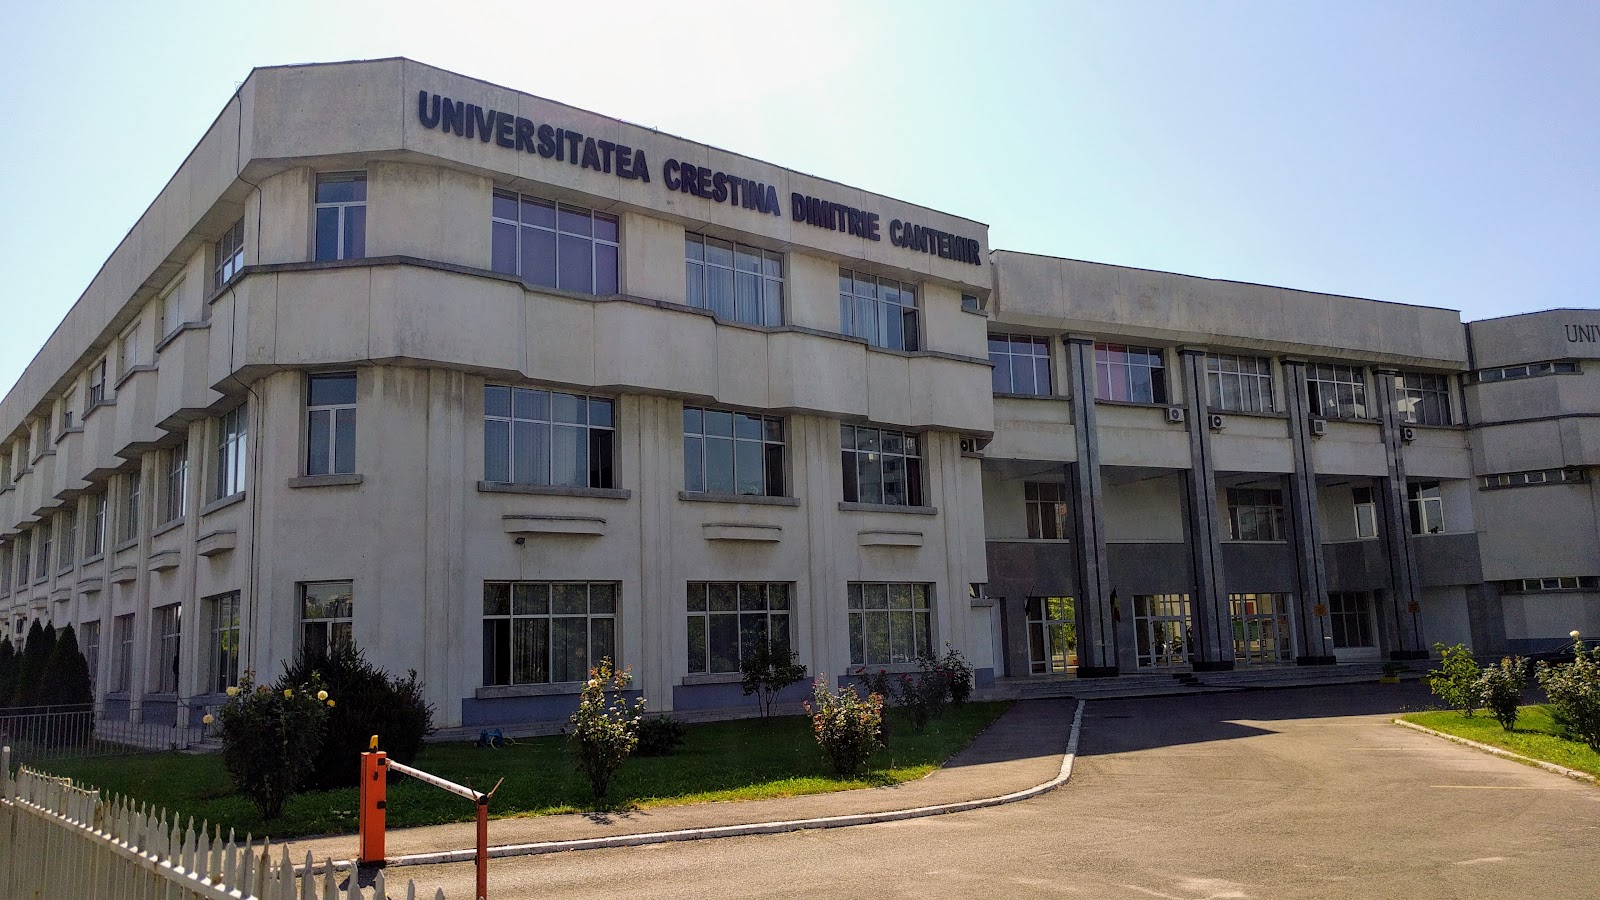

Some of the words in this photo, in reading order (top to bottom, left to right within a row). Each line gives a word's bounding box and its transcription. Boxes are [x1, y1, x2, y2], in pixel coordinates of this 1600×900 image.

[419, 90, 650, 183] UNIVERSITATEA
[663, 159, 780, 216] CRESTINA
[791, 192, 880, 241] DIMITRIE
[890, 219, 981, 266] CANTEMIR
